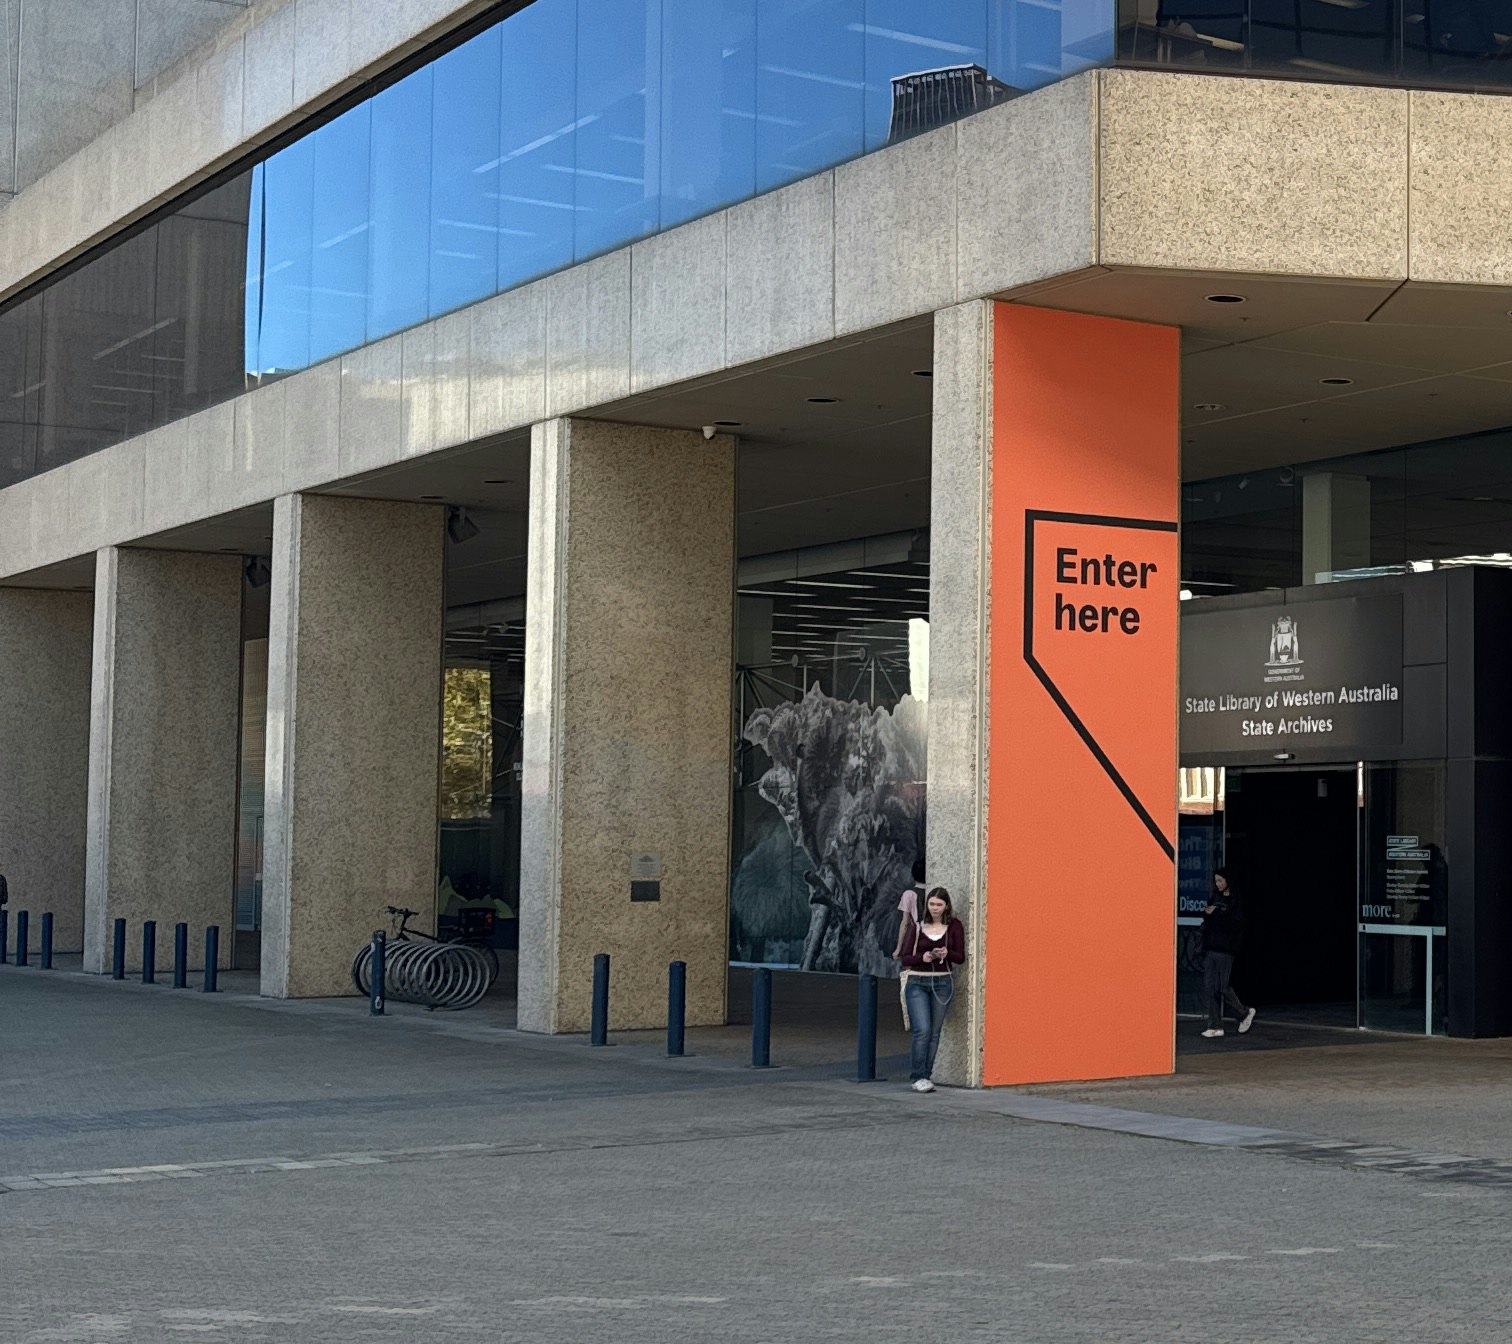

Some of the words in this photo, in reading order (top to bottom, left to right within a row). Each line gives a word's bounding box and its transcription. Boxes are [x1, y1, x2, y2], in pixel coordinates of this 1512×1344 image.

[1057, 547, 1157, 589] Enter
[1055, 593, 1140, 635] here
[1185, 697, 1216, 714] State
[1219, 693, 1262, 712] Library
[1265, 691, 1279, 709] of
[1281, 688, 1335, 707] Western
[1338, 683, 1399, 705] Australia
[1242, 719, 1274, 737] State
[1277, 715, 1333, 735] Archives
